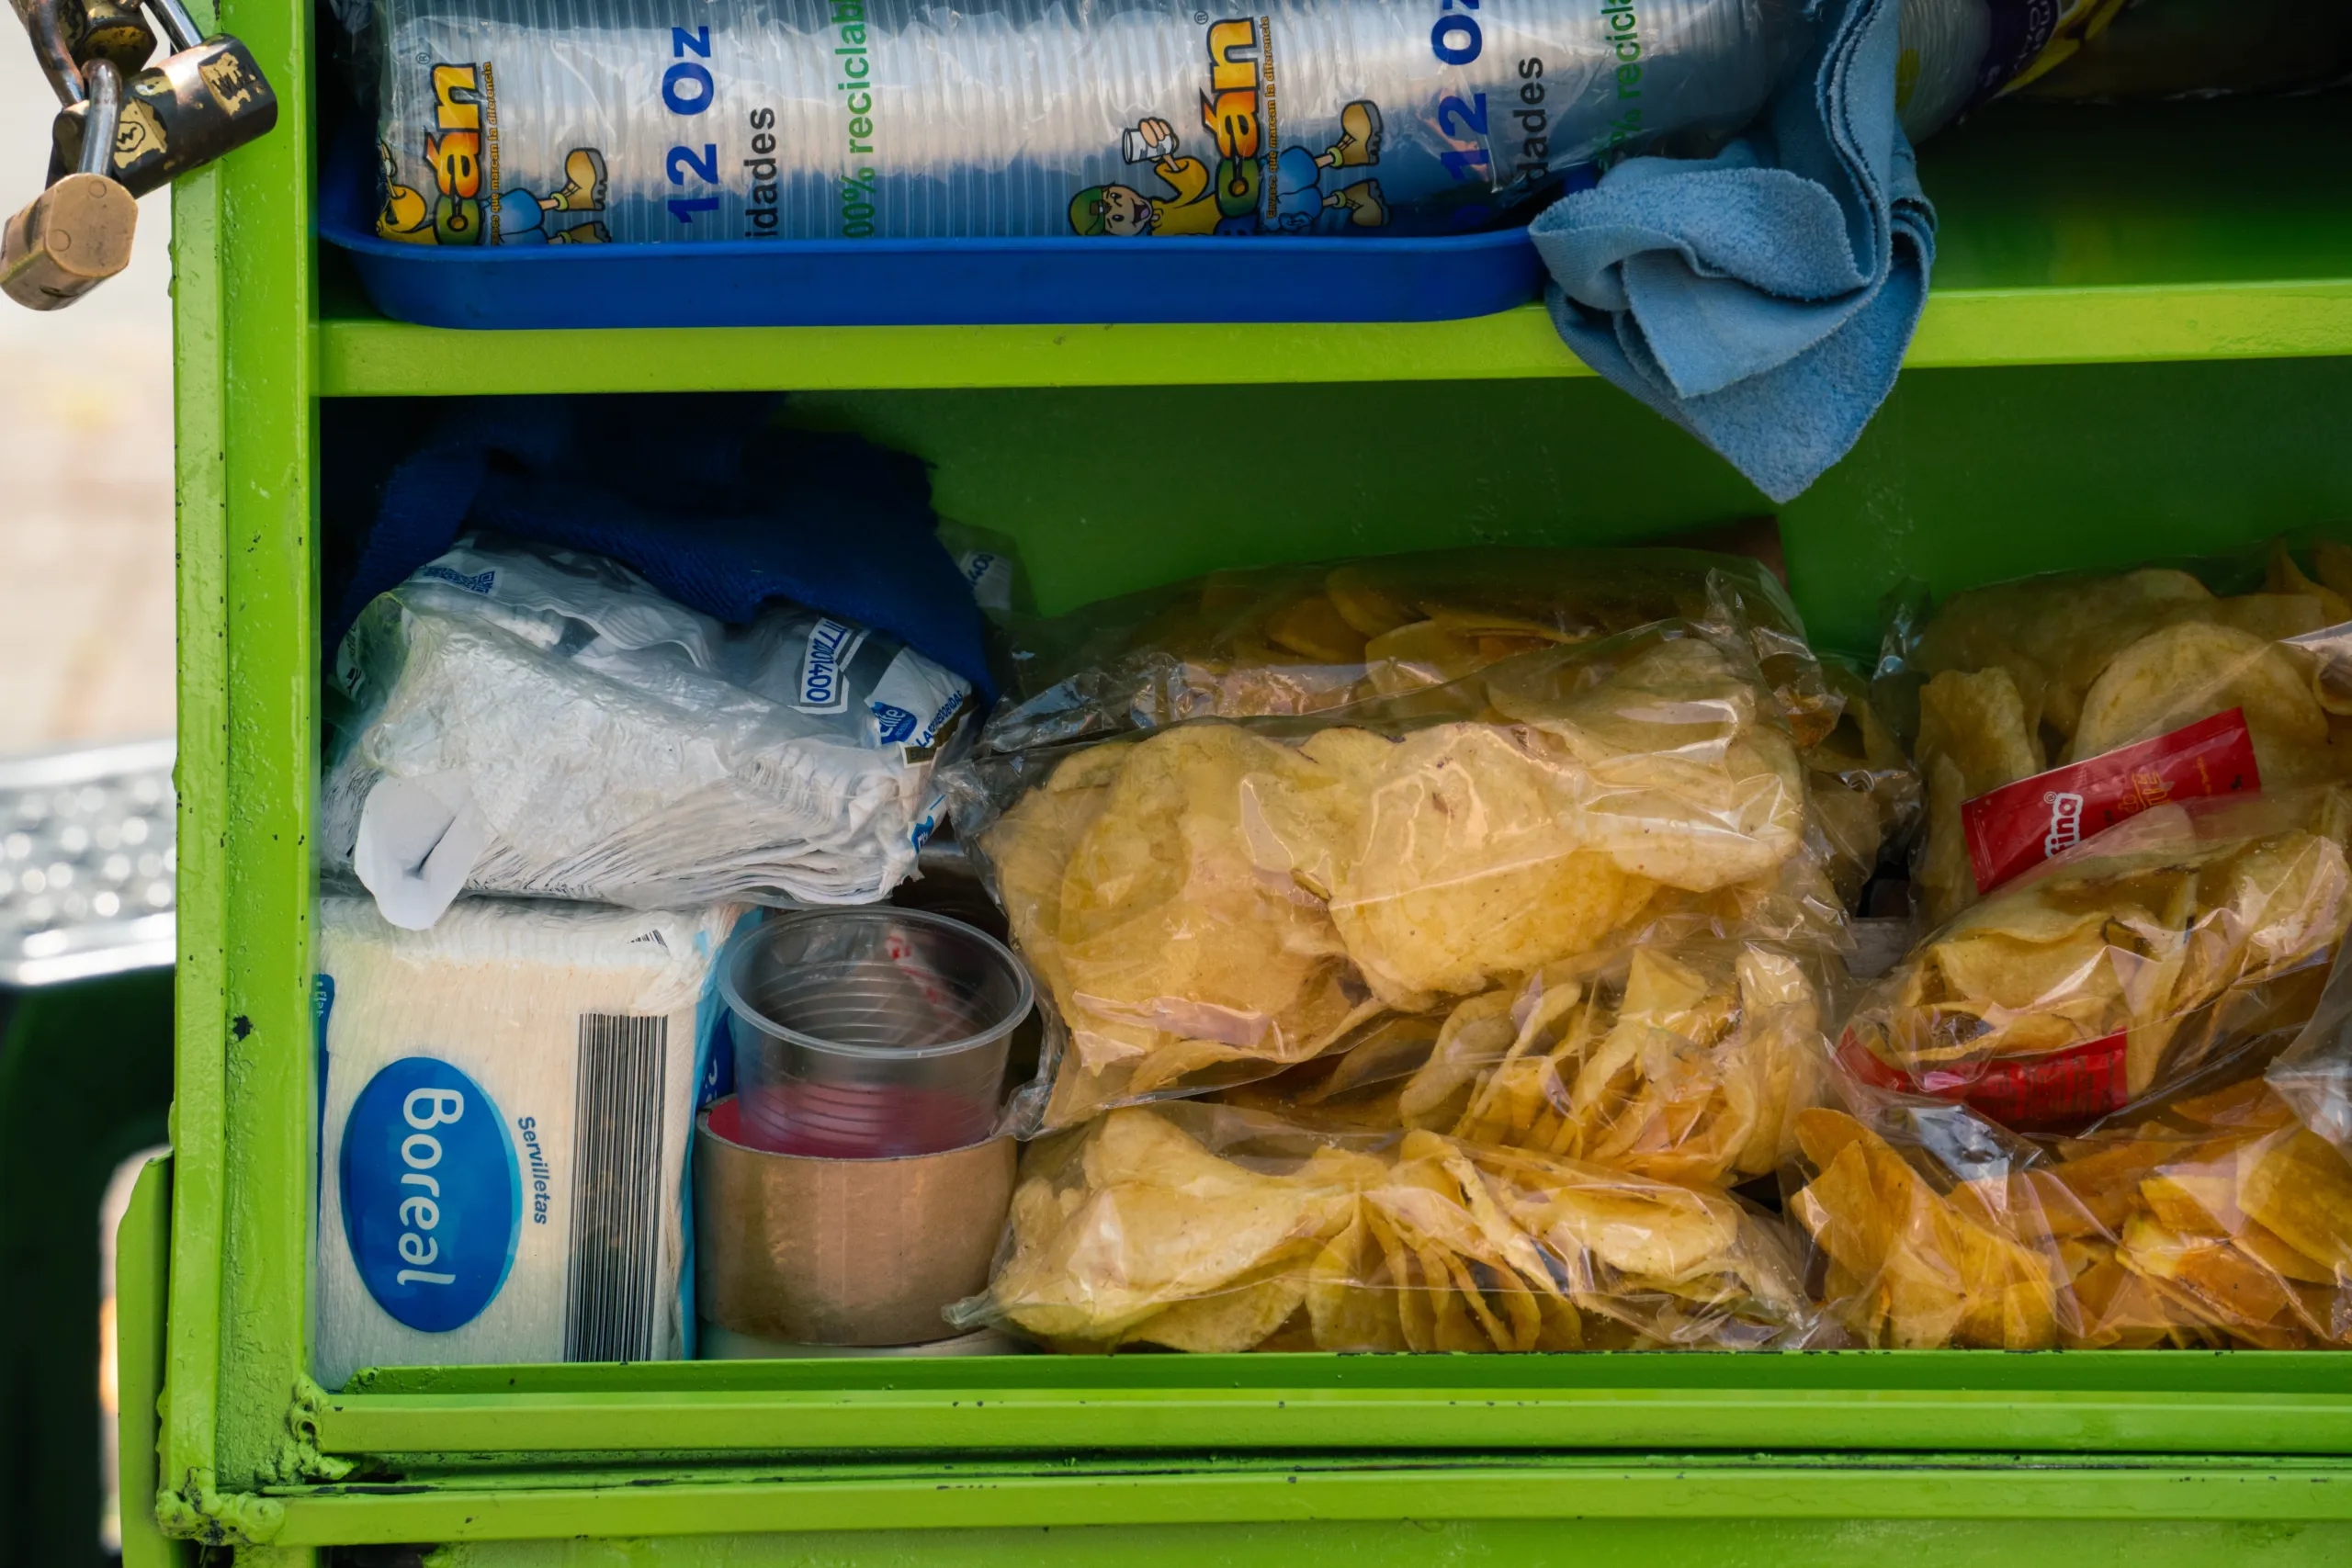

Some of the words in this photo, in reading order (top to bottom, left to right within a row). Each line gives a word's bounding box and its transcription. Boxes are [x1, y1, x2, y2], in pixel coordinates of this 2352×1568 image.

[1260, 16, 1274, 81] diferencia
[1430, 0, 1483, 65] O
[1600, 0, 1644, 100] recicl
[481, 61, 497, 126] diferencia
[1264, 84, 1275, 97] la
[488, 128, 499, 141] la
[1268, 99, 1277, 148] marcan
[1438, 92, 1490, 181] 12
[490, 144, 500, 190] marcan
[666, 143, 719, 223] 12
[742, 107, 779, 238] idades
[1268, 150, 1279, 173] que
[491, 193, 502, 213] que
[1267, 175, 1277, 219] Envases
[397, 1087, 465, 1287] Boreal
